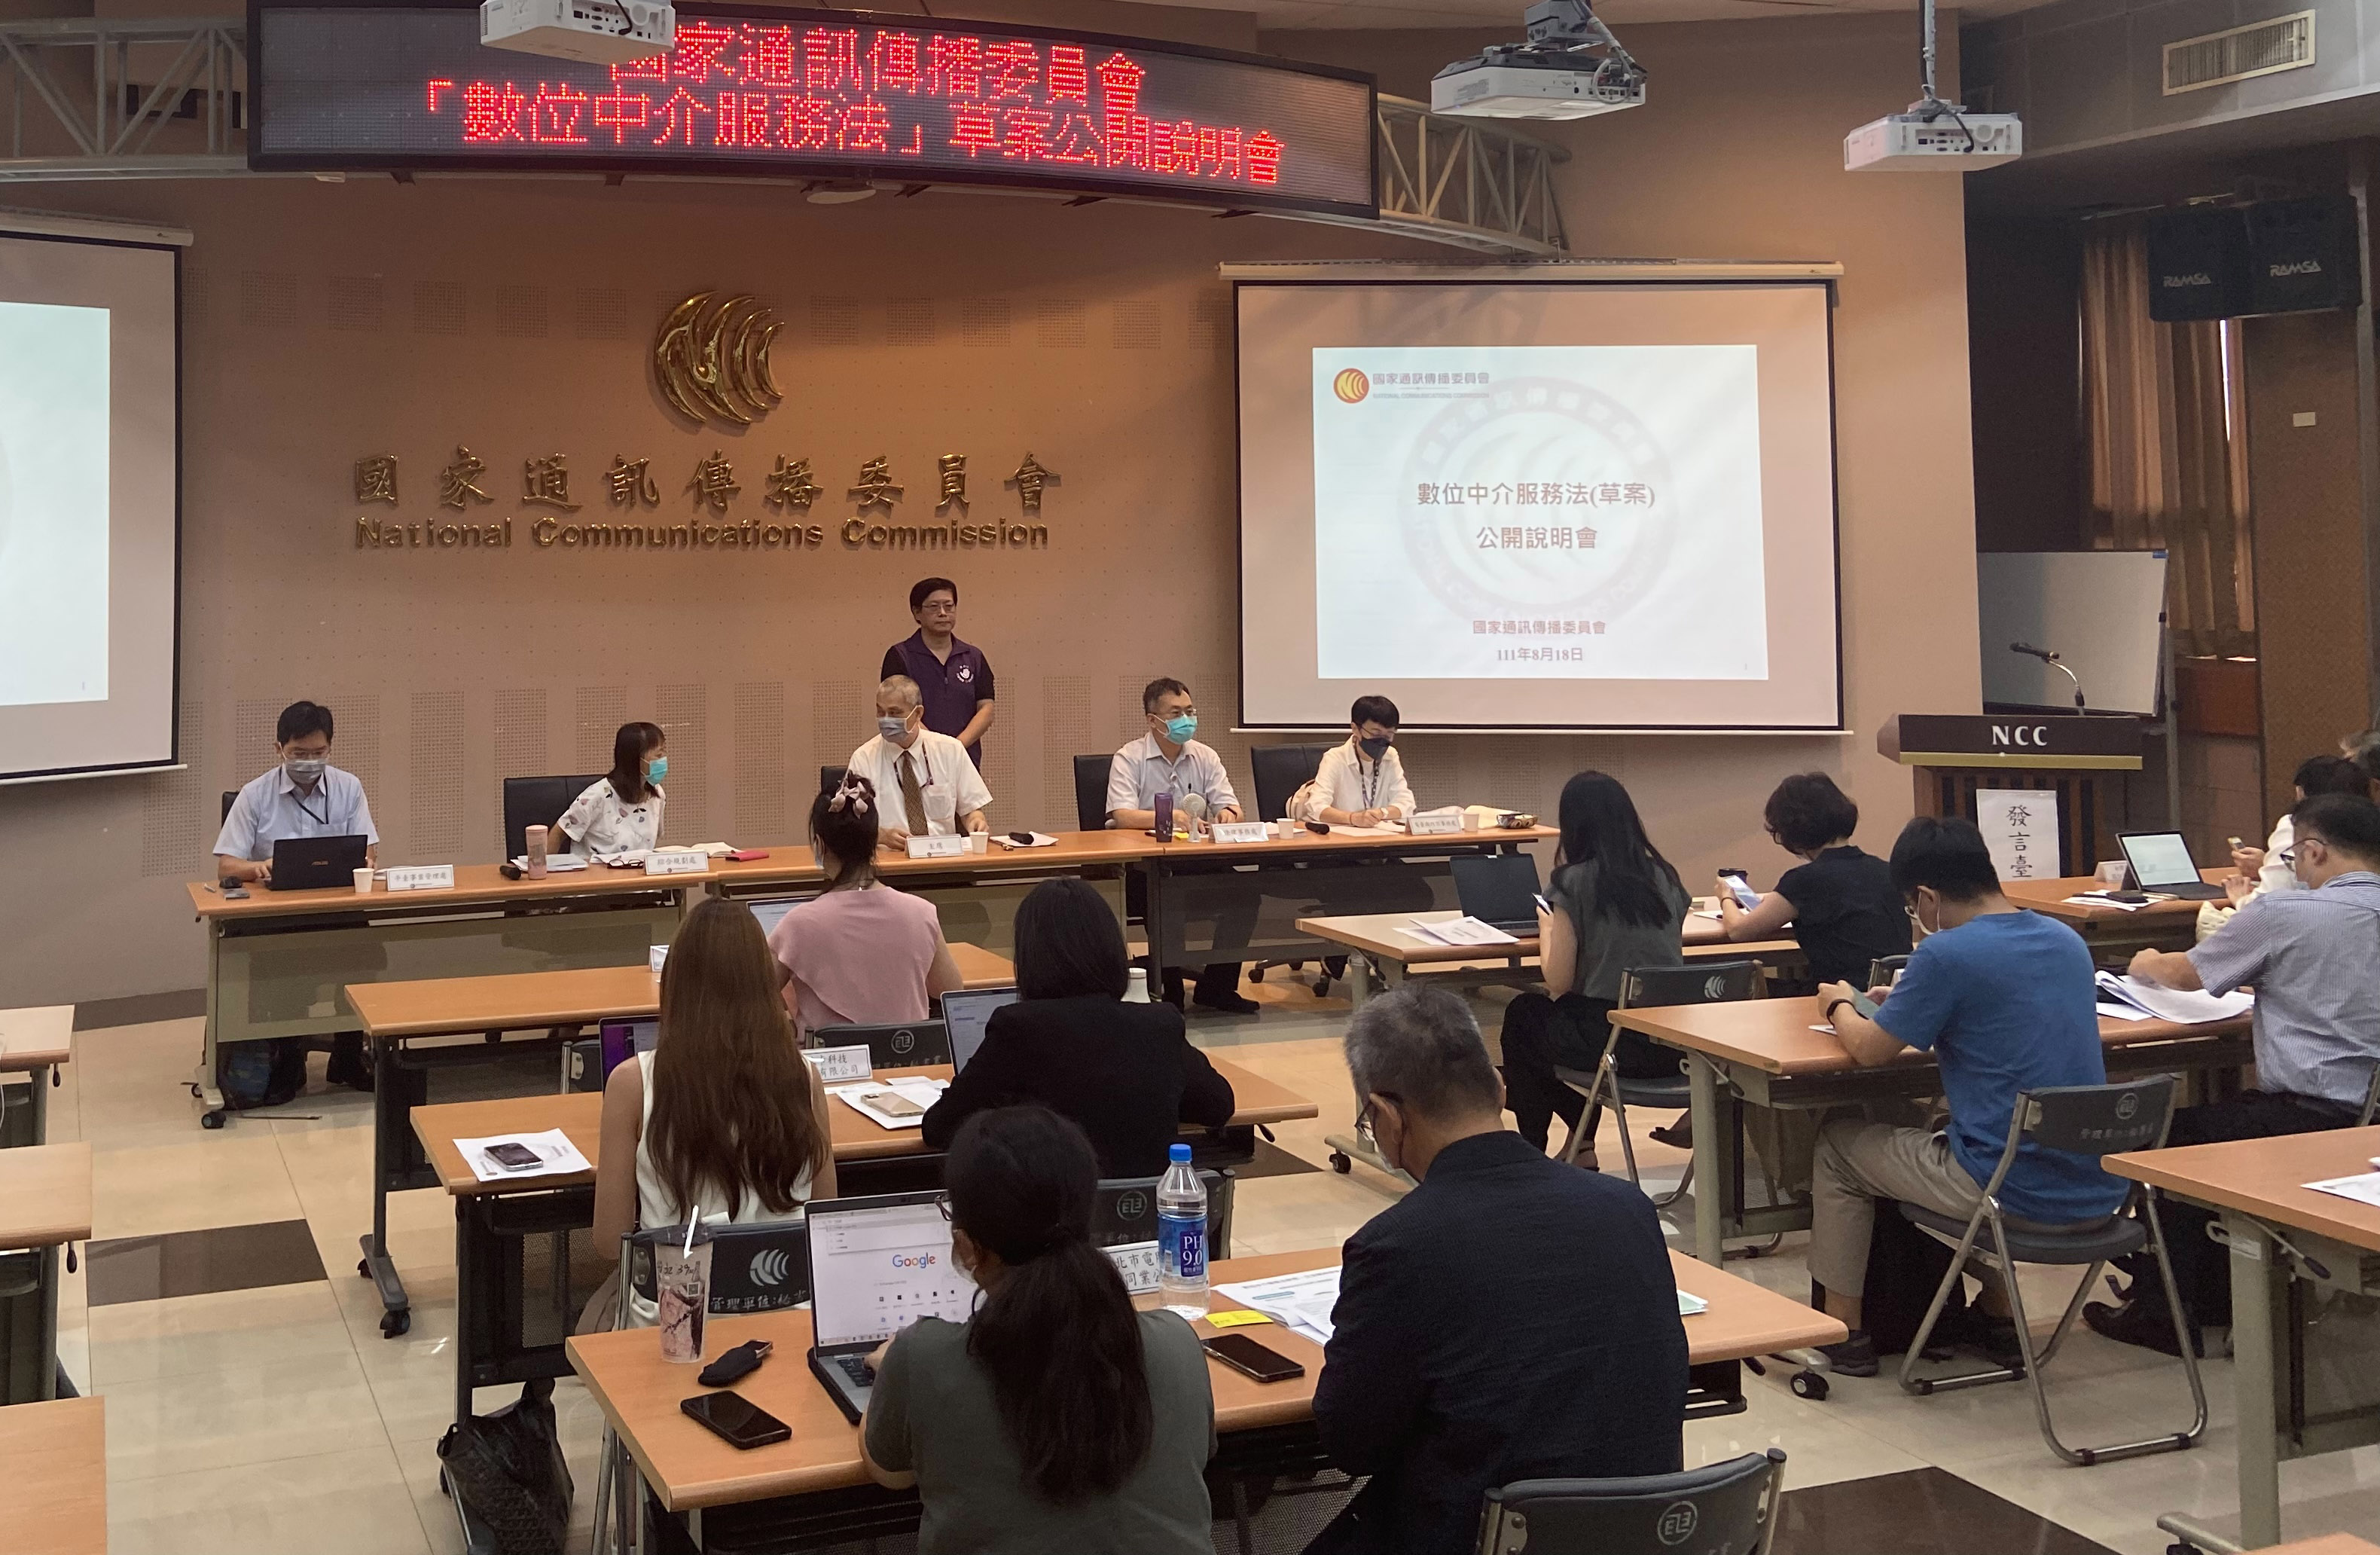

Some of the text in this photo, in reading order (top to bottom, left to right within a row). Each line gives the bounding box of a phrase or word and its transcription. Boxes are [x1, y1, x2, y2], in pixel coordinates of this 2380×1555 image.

[354, 445, 1062, 511] 國家通訊傳播委員會
[1417, 481, 1656, 509] 數位中介服務法(草案)
[355, 515, 1049, 548] National Communications Commission
[1475, 525, 1598, 550] 公開說明會
[1472, 619, 1606, 635] 國家通訊傳播委員會
[1496, 646, 1584, 662] 111年8月18日
[1991, 725, 2048, 747] NCC
[2006, 804, 2033, 878] 發言臺
[1183, 1235, 1203, 1250] PH
[892, 1251, 936, 1269] Google
[1182, 1249, 1204, 1266] 9.0
